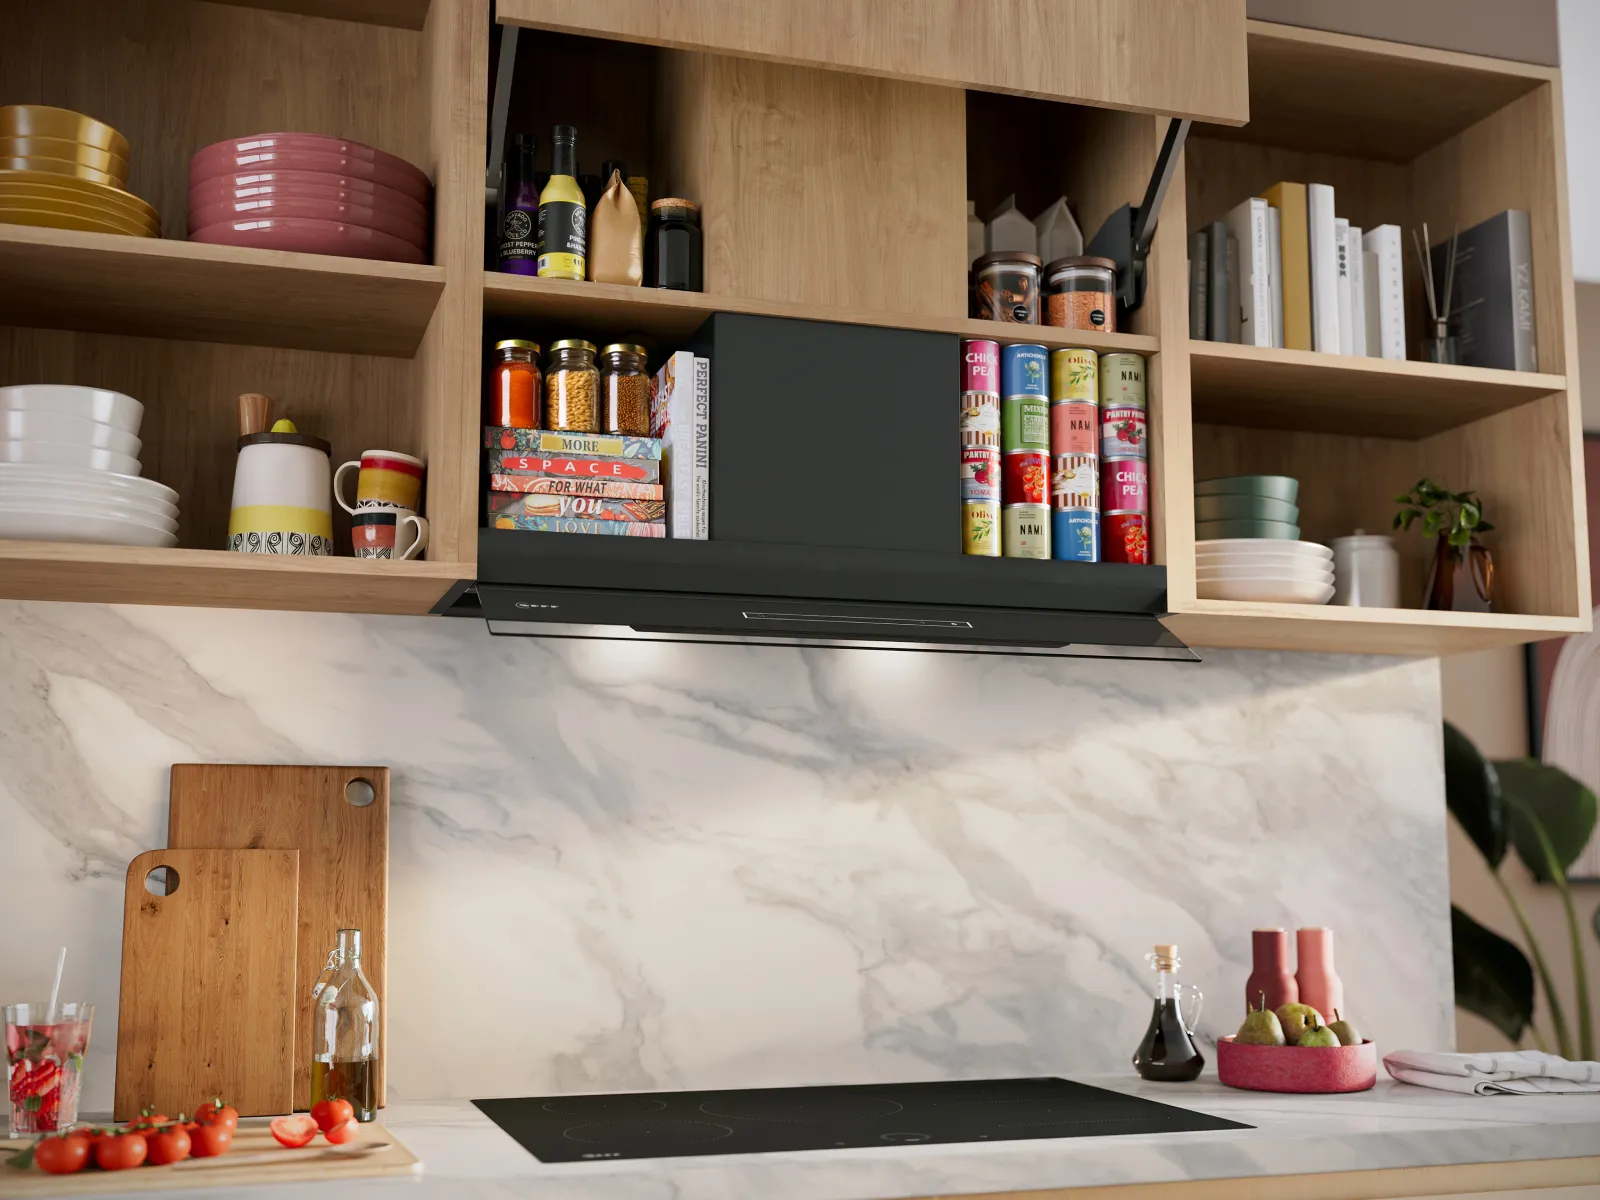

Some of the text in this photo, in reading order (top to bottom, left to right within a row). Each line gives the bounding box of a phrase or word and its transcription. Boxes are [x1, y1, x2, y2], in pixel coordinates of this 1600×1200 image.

[503, 248, 537, 256] BLUEBERRY
[1518, 289, 1531, 331] KAMI
[965, 352, 998, 366] CHICK
[695, 361, 709, 469] PERFECT PANINI
[1106, 410, 1131, 419] PANTRY
[561, 438, 599, 452] MORE
[519, 458, 622, 475] SPACE
[1115, 471, 1148, 484] CHICK
[549, 480, 608, 494] FOR WHAT
[559, 496, 604, 517] you
